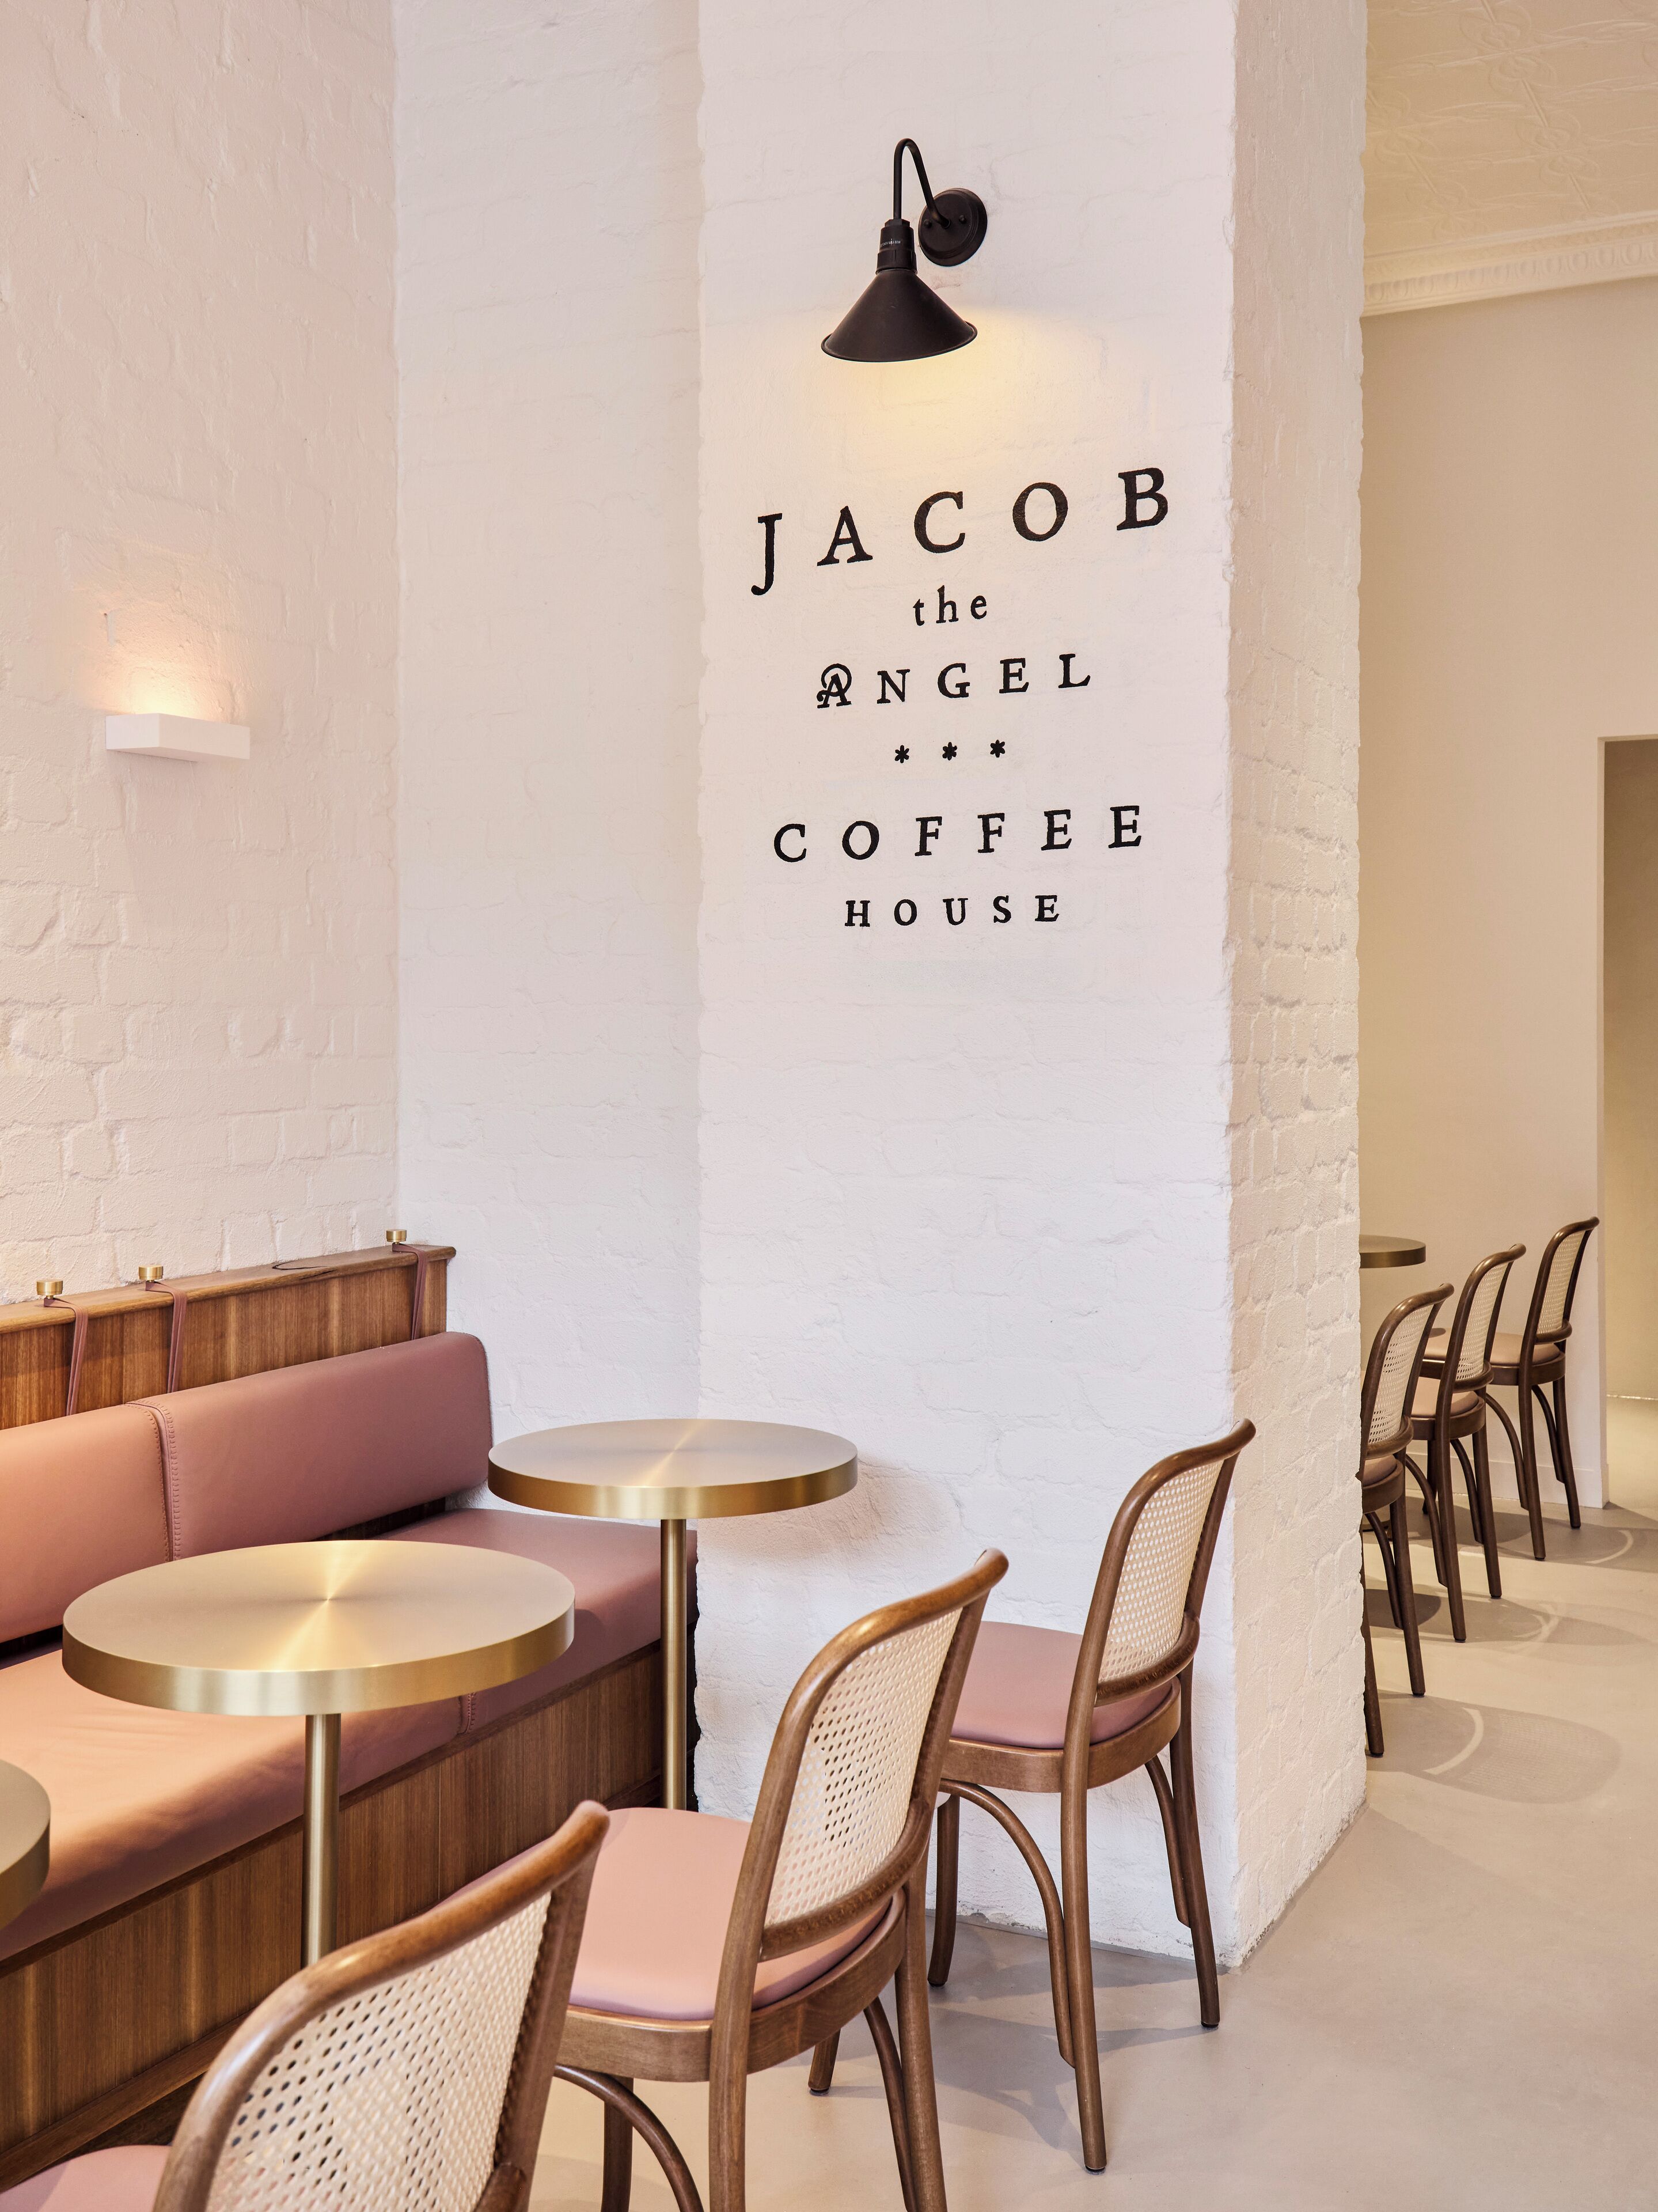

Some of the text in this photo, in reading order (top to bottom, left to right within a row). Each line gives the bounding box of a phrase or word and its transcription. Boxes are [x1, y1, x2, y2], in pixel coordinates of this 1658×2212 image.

[750, 467, 1168, 596] JACOB
[912, 585, 987, 626] the
[816, 653, 1091, 709] ANGEL
[773, 805, 1142, 863] COFFEE
[844, 895, 1060, 927] HOUSE
